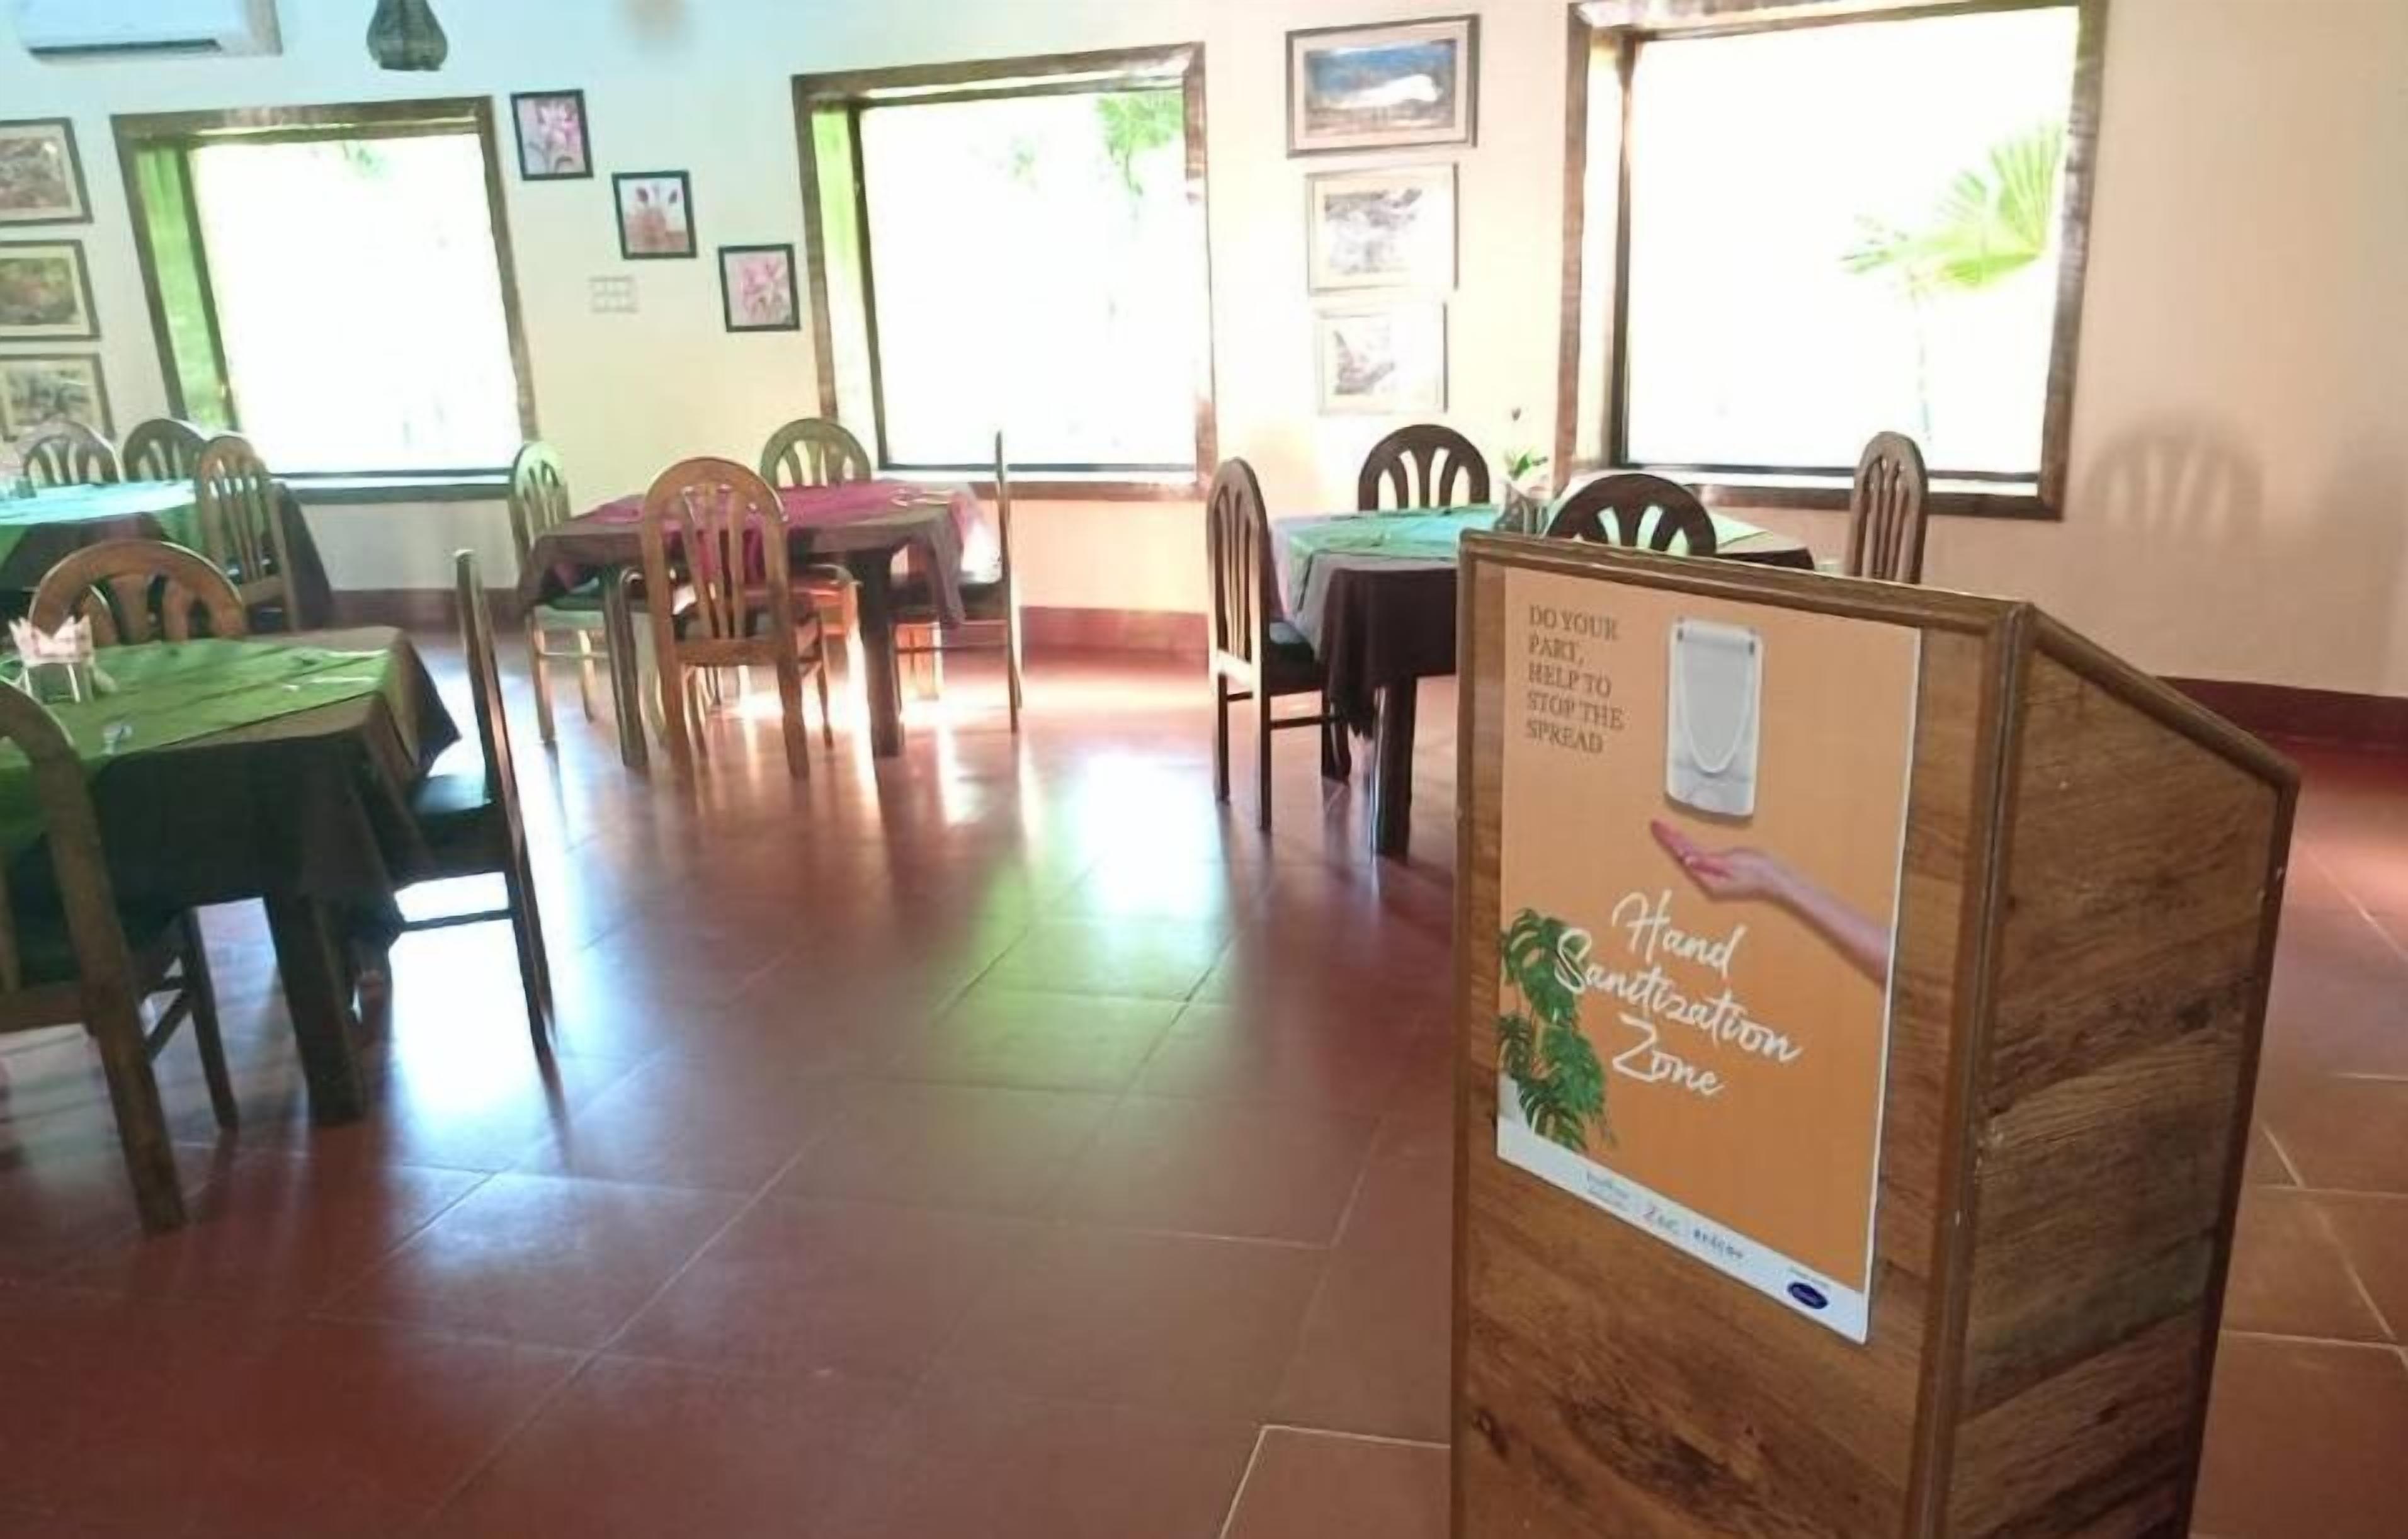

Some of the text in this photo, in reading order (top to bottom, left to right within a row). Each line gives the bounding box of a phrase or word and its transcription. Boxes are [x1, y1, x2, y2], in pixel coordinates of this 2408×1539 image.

[1529, 605, 1619, 641] DO YOUR
[1528, 662, 1612, 698] HELP TO
[1526, 690, 1625, 731] STOP THE
[1526, 719, 1603, 754] SPREAD
[1611, 889, 1748, 979] Hand
[1553, 927, 1803, 1063] Sanitization
[1611, 1012, 1727, 1096] Zone
